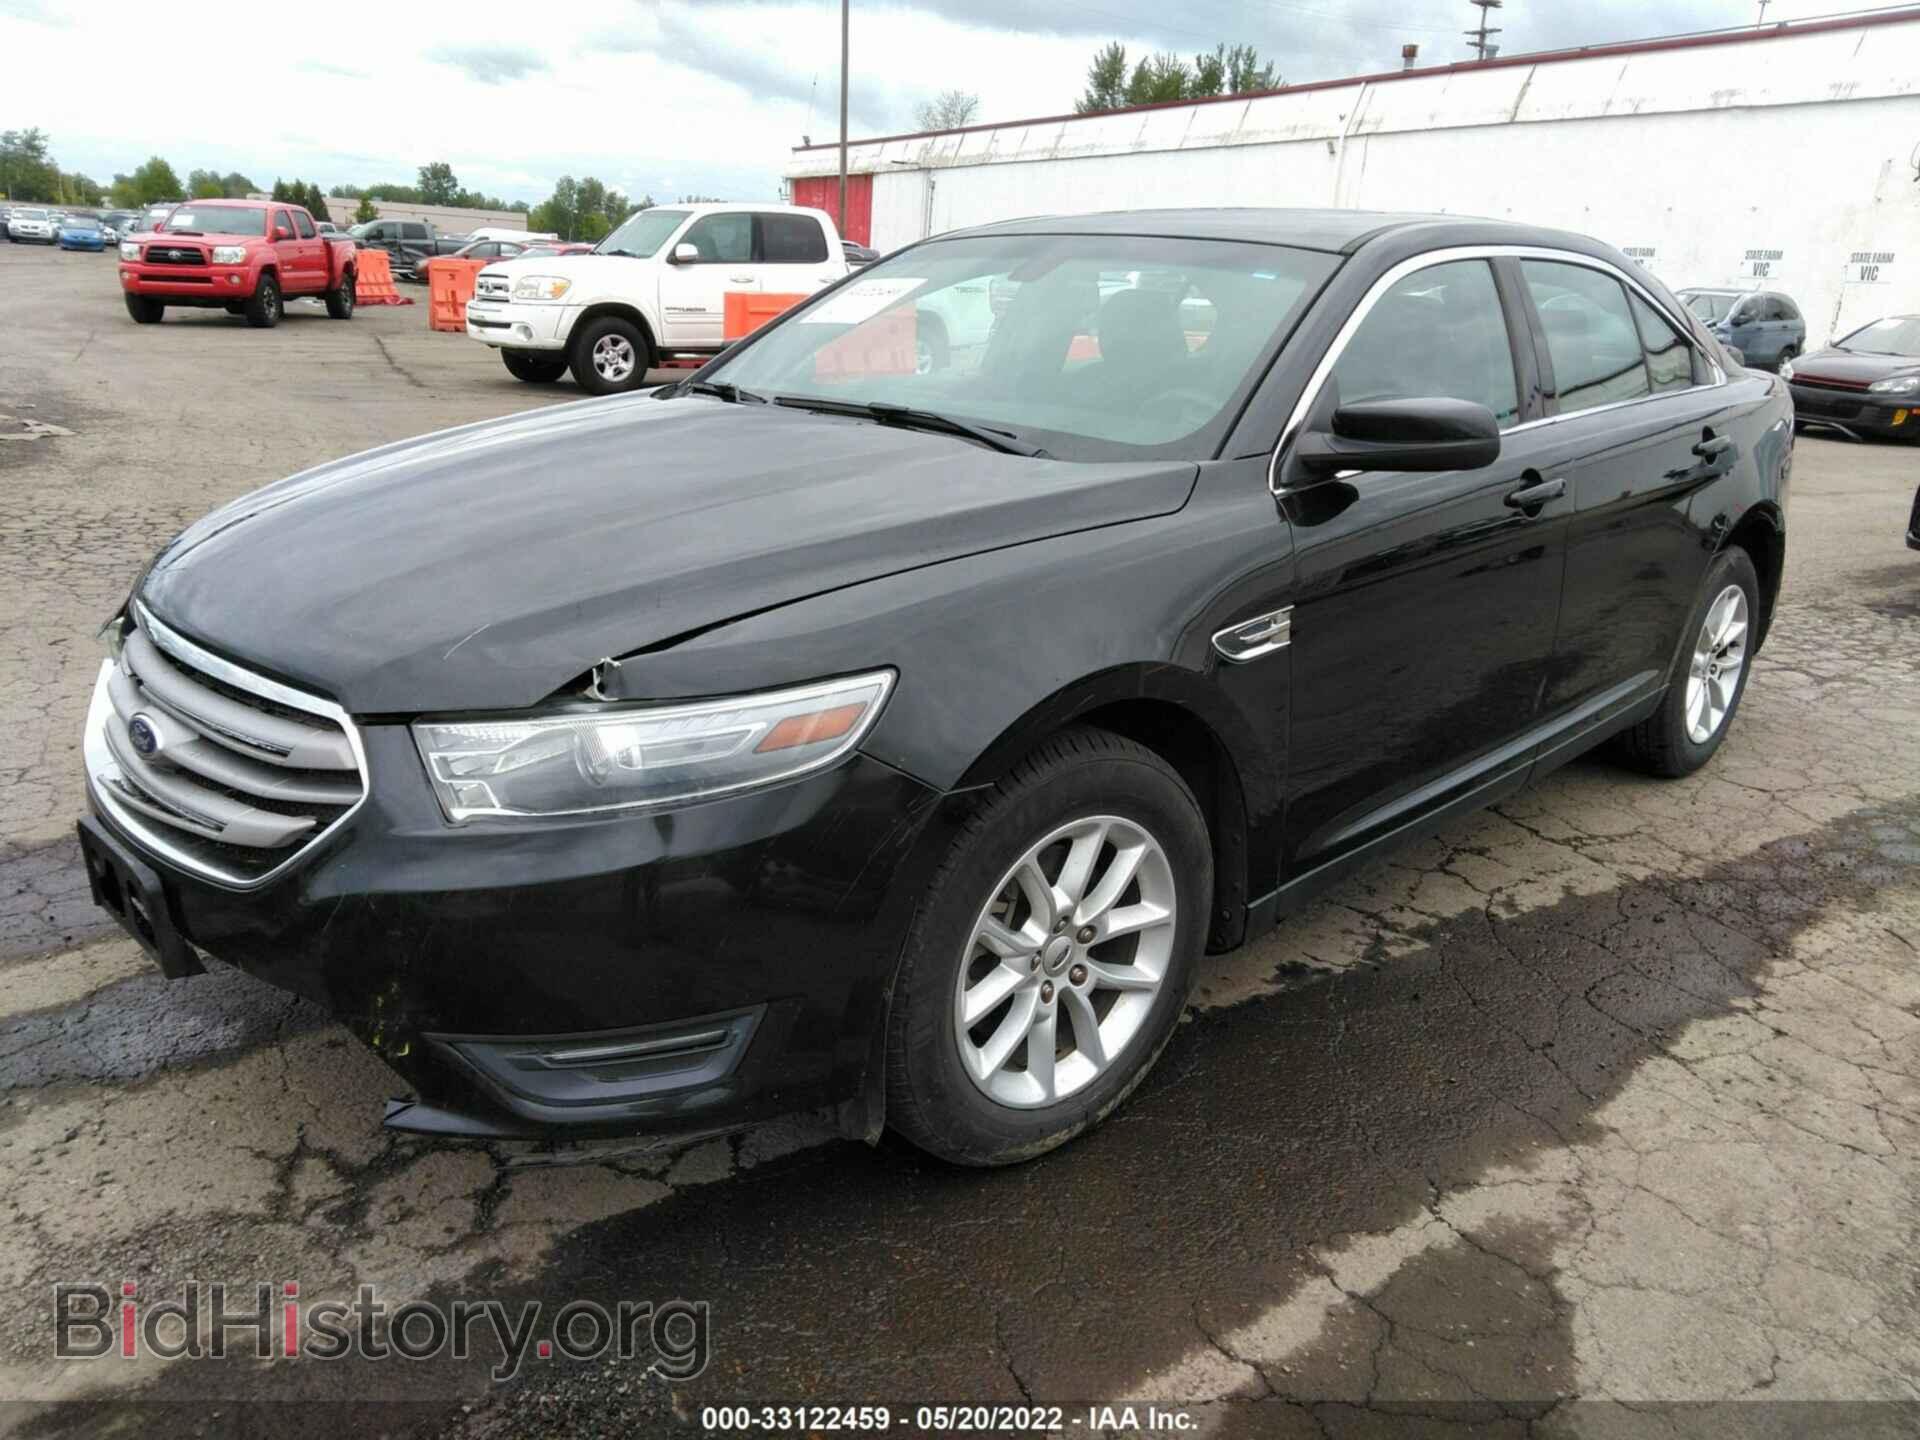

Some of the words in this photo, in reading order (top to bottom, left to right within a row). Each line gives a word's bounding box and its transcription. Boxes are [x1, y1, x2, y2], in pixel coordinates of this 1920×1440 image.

[1745, 250, 1763, 260] STATE
[1763, 250, 1783, 260] FARM
[1850, 252, 1871, 263] STATE
[1872, 253, 1895, 264] FARM
[1753, 262, 1770, 277] VIC
[1860, 265, 1879, 281] VIC
